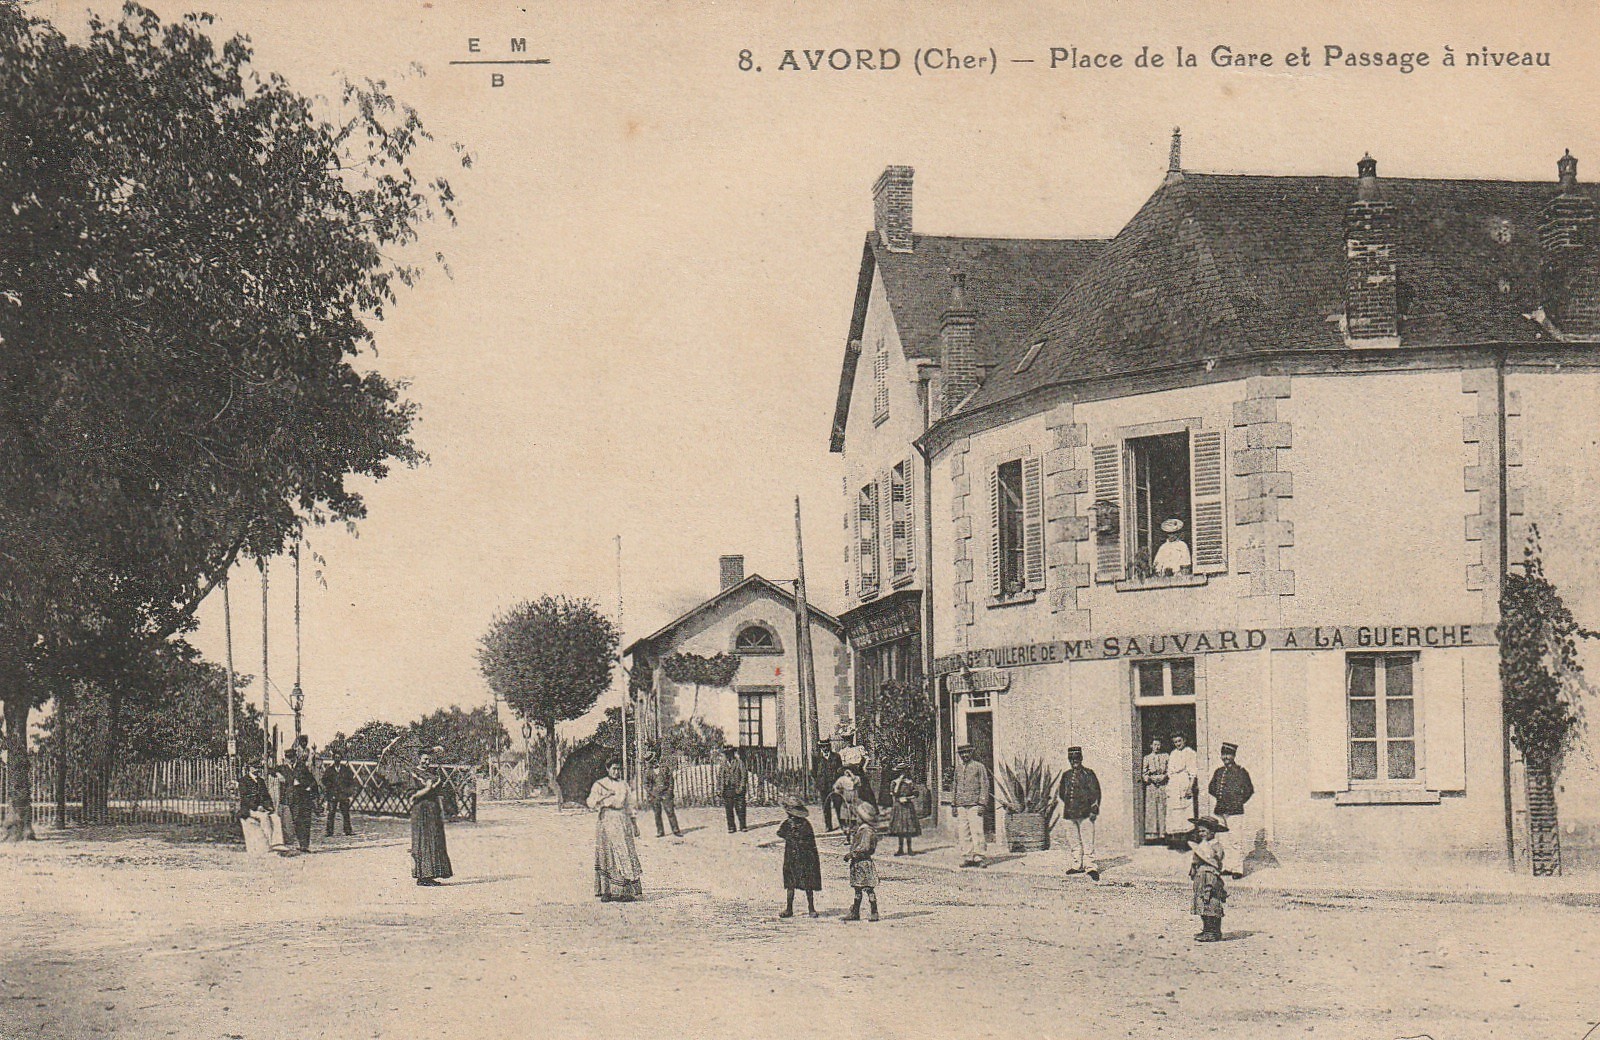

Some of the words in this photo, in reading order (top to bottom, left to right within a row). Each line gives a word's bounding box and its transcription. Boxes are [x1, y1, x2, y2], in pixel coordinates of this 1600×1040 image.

[983, 644, 1038, 667] TUILERIE
[1041, 644, 1056, 661] DE
[1103, 629, 1266, 657] SAUVARD
[1314, 627, 1344, 647] LA
[1357, 625, 1473, 646] GUERCHE
